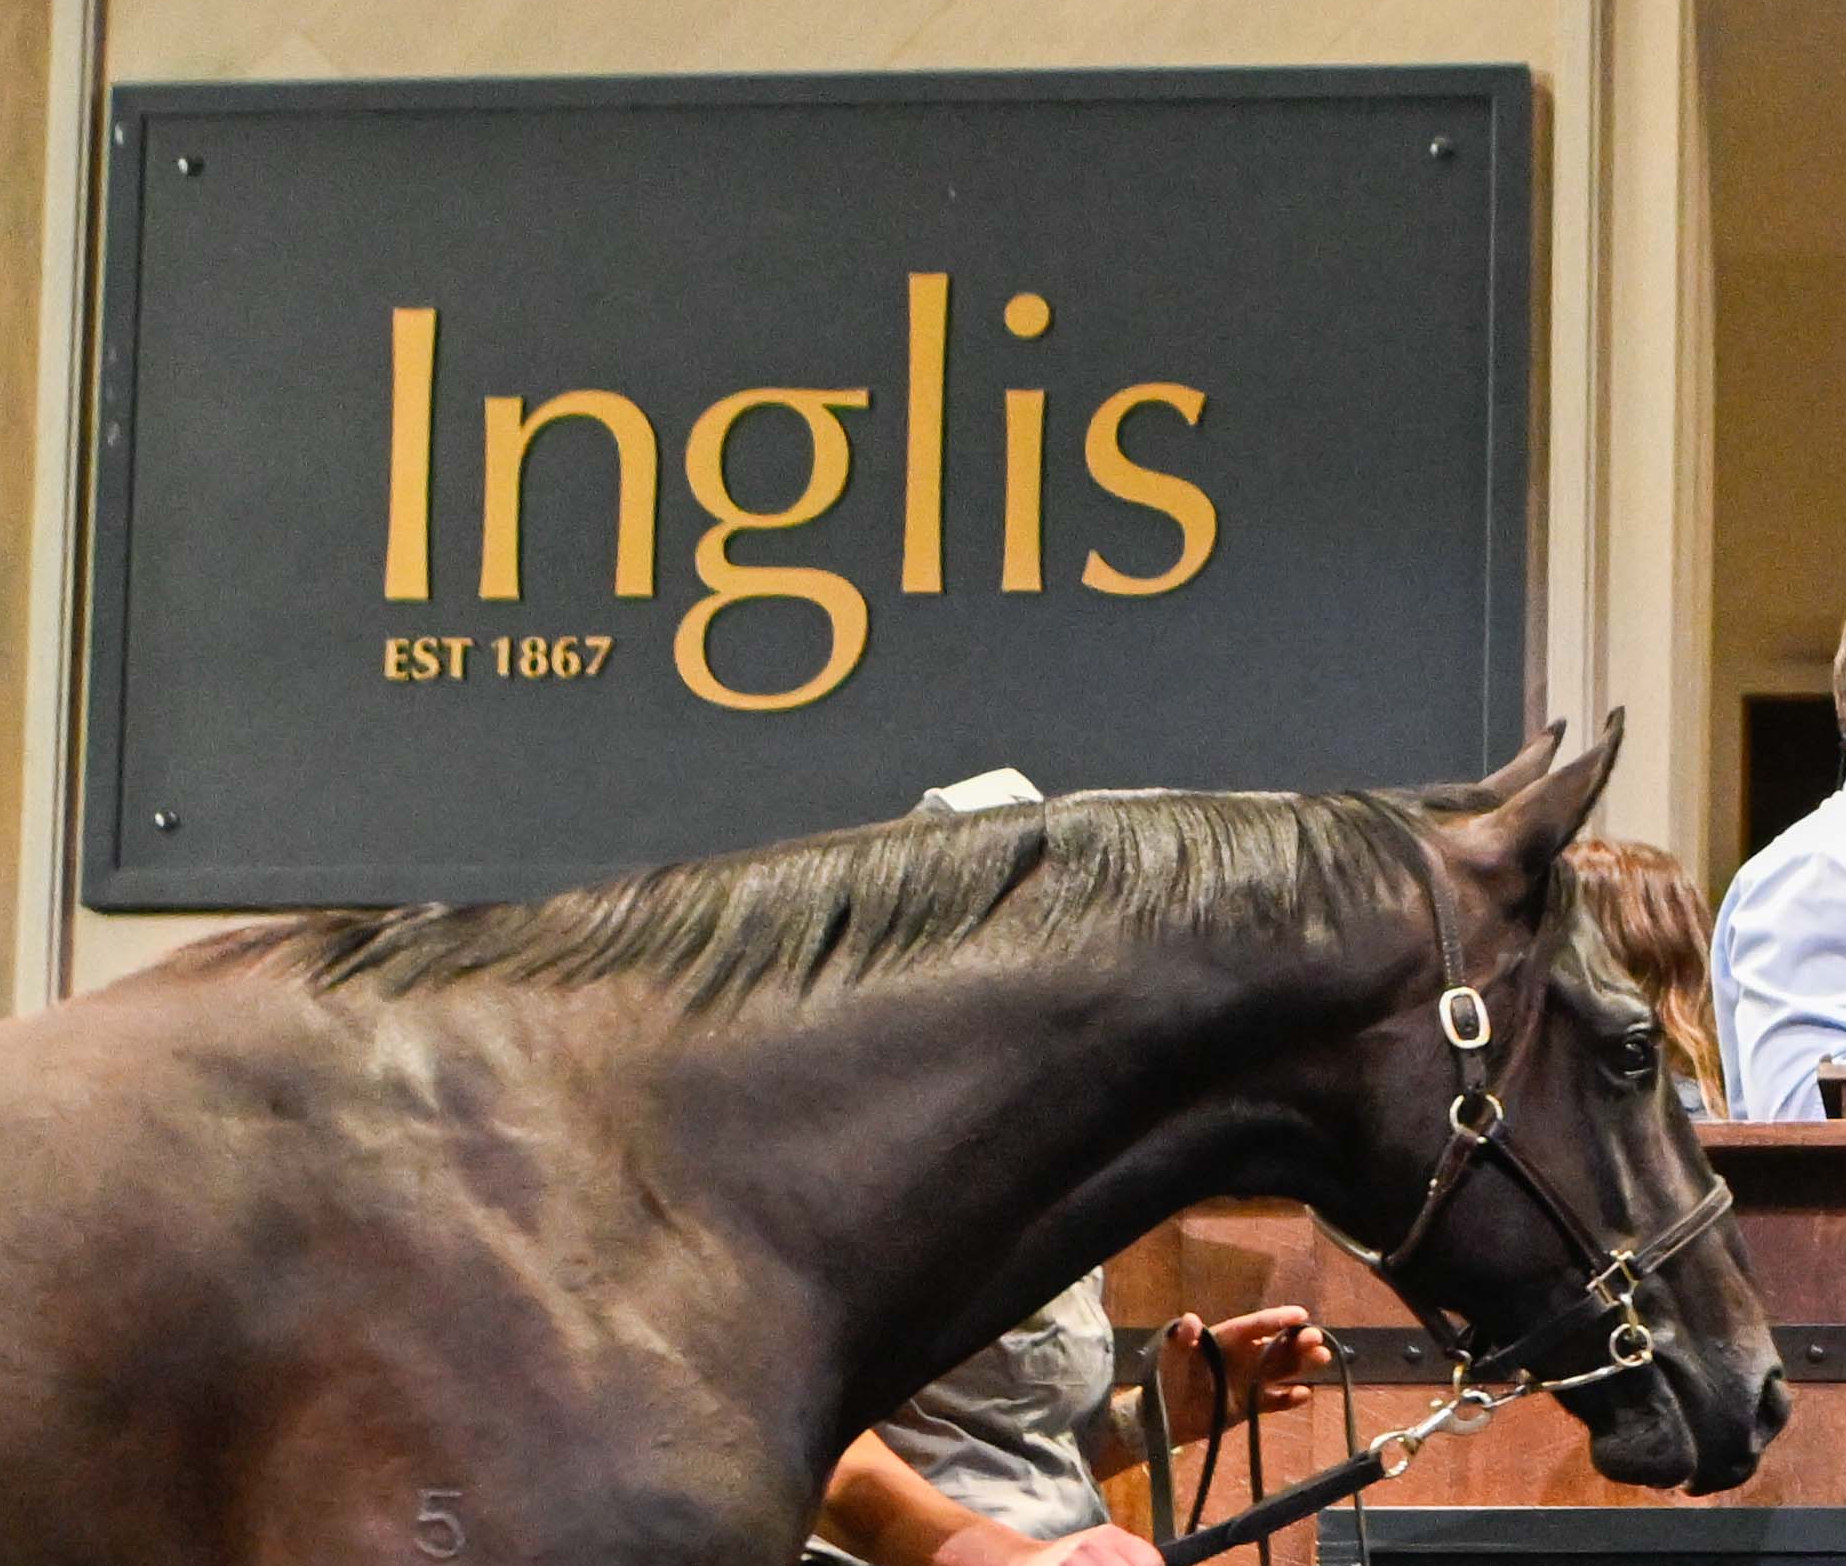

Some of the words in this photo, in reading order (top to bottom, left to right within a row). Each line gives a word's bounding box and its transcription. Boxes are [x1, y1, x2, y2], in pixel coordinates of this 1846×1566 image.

[383, 271, 1219, 710] Inglis
[383, 636, 475, 682] EST
[489, 634, 615, 680] 1867
[415, 1488, 467, 1559] 5
